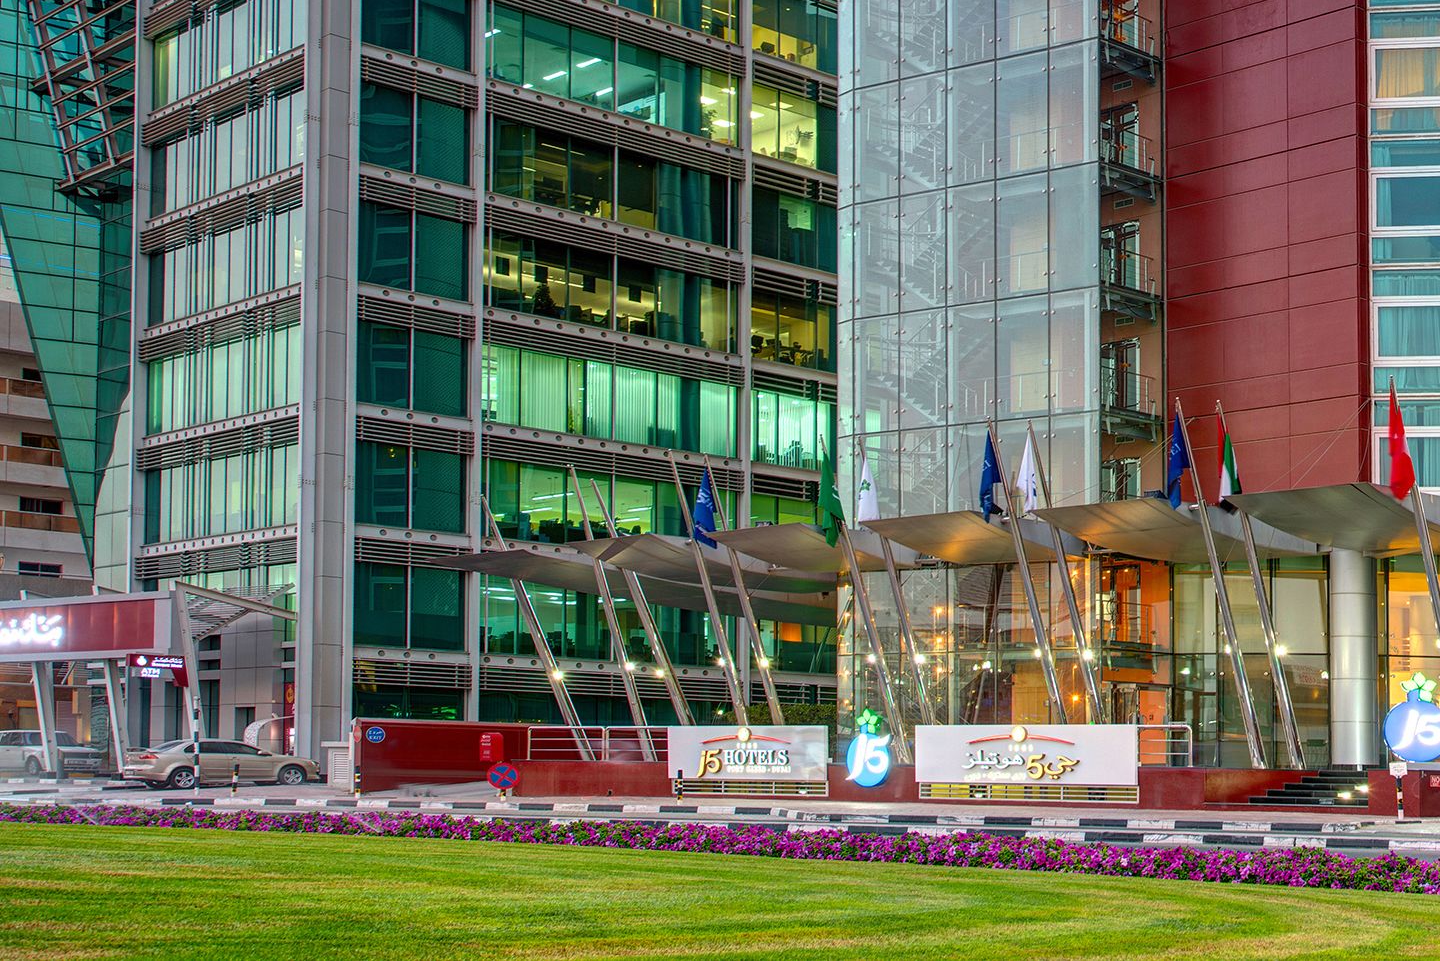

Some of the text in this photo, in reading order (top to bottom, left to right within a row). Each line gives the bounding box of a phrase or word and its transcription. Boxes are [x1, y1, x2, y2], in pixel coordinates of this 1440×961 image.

[141, 667, 160, 675] ATM
[724, 749, 788, 766] HOTELS
[961, 750, 1025, 770] هوتيلز
